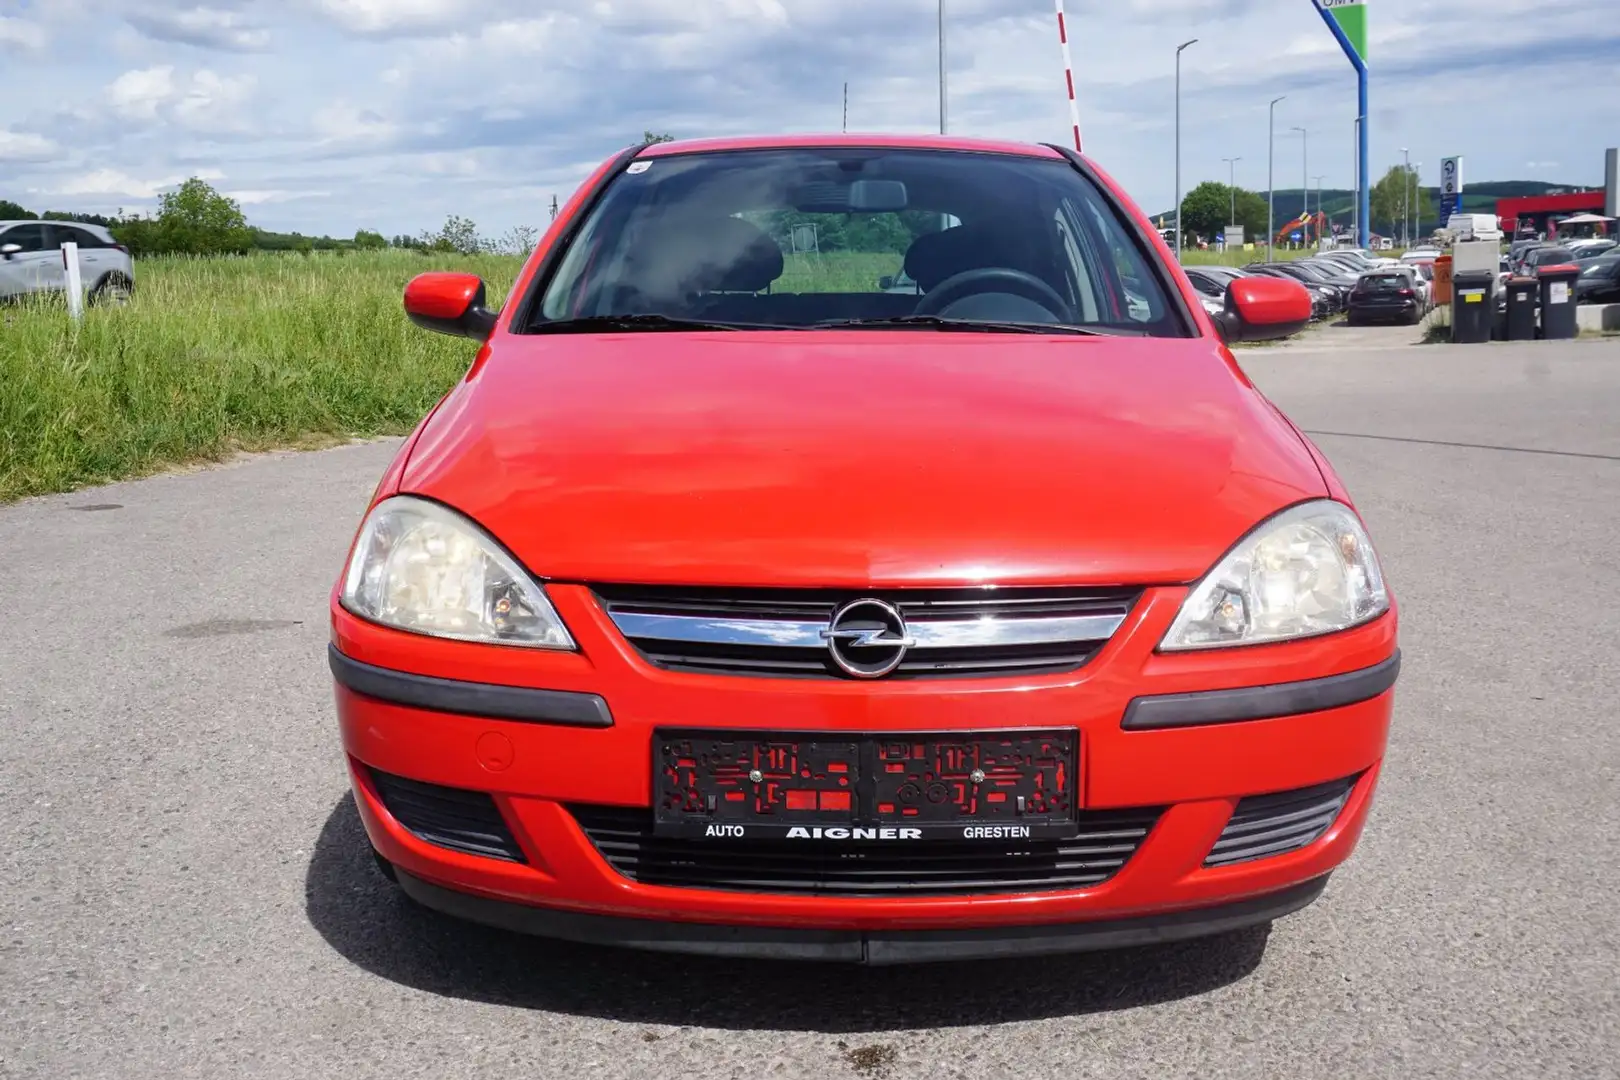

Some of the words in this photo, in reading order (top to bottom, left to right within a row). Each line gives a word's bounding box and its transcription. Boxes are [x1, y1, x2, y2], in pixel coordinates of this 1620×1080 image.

[705, 825, 745, 838] AUTO
[785, 826, 923, 840] AIGNER
[963, 826, 1030, 839] GRESTEN
